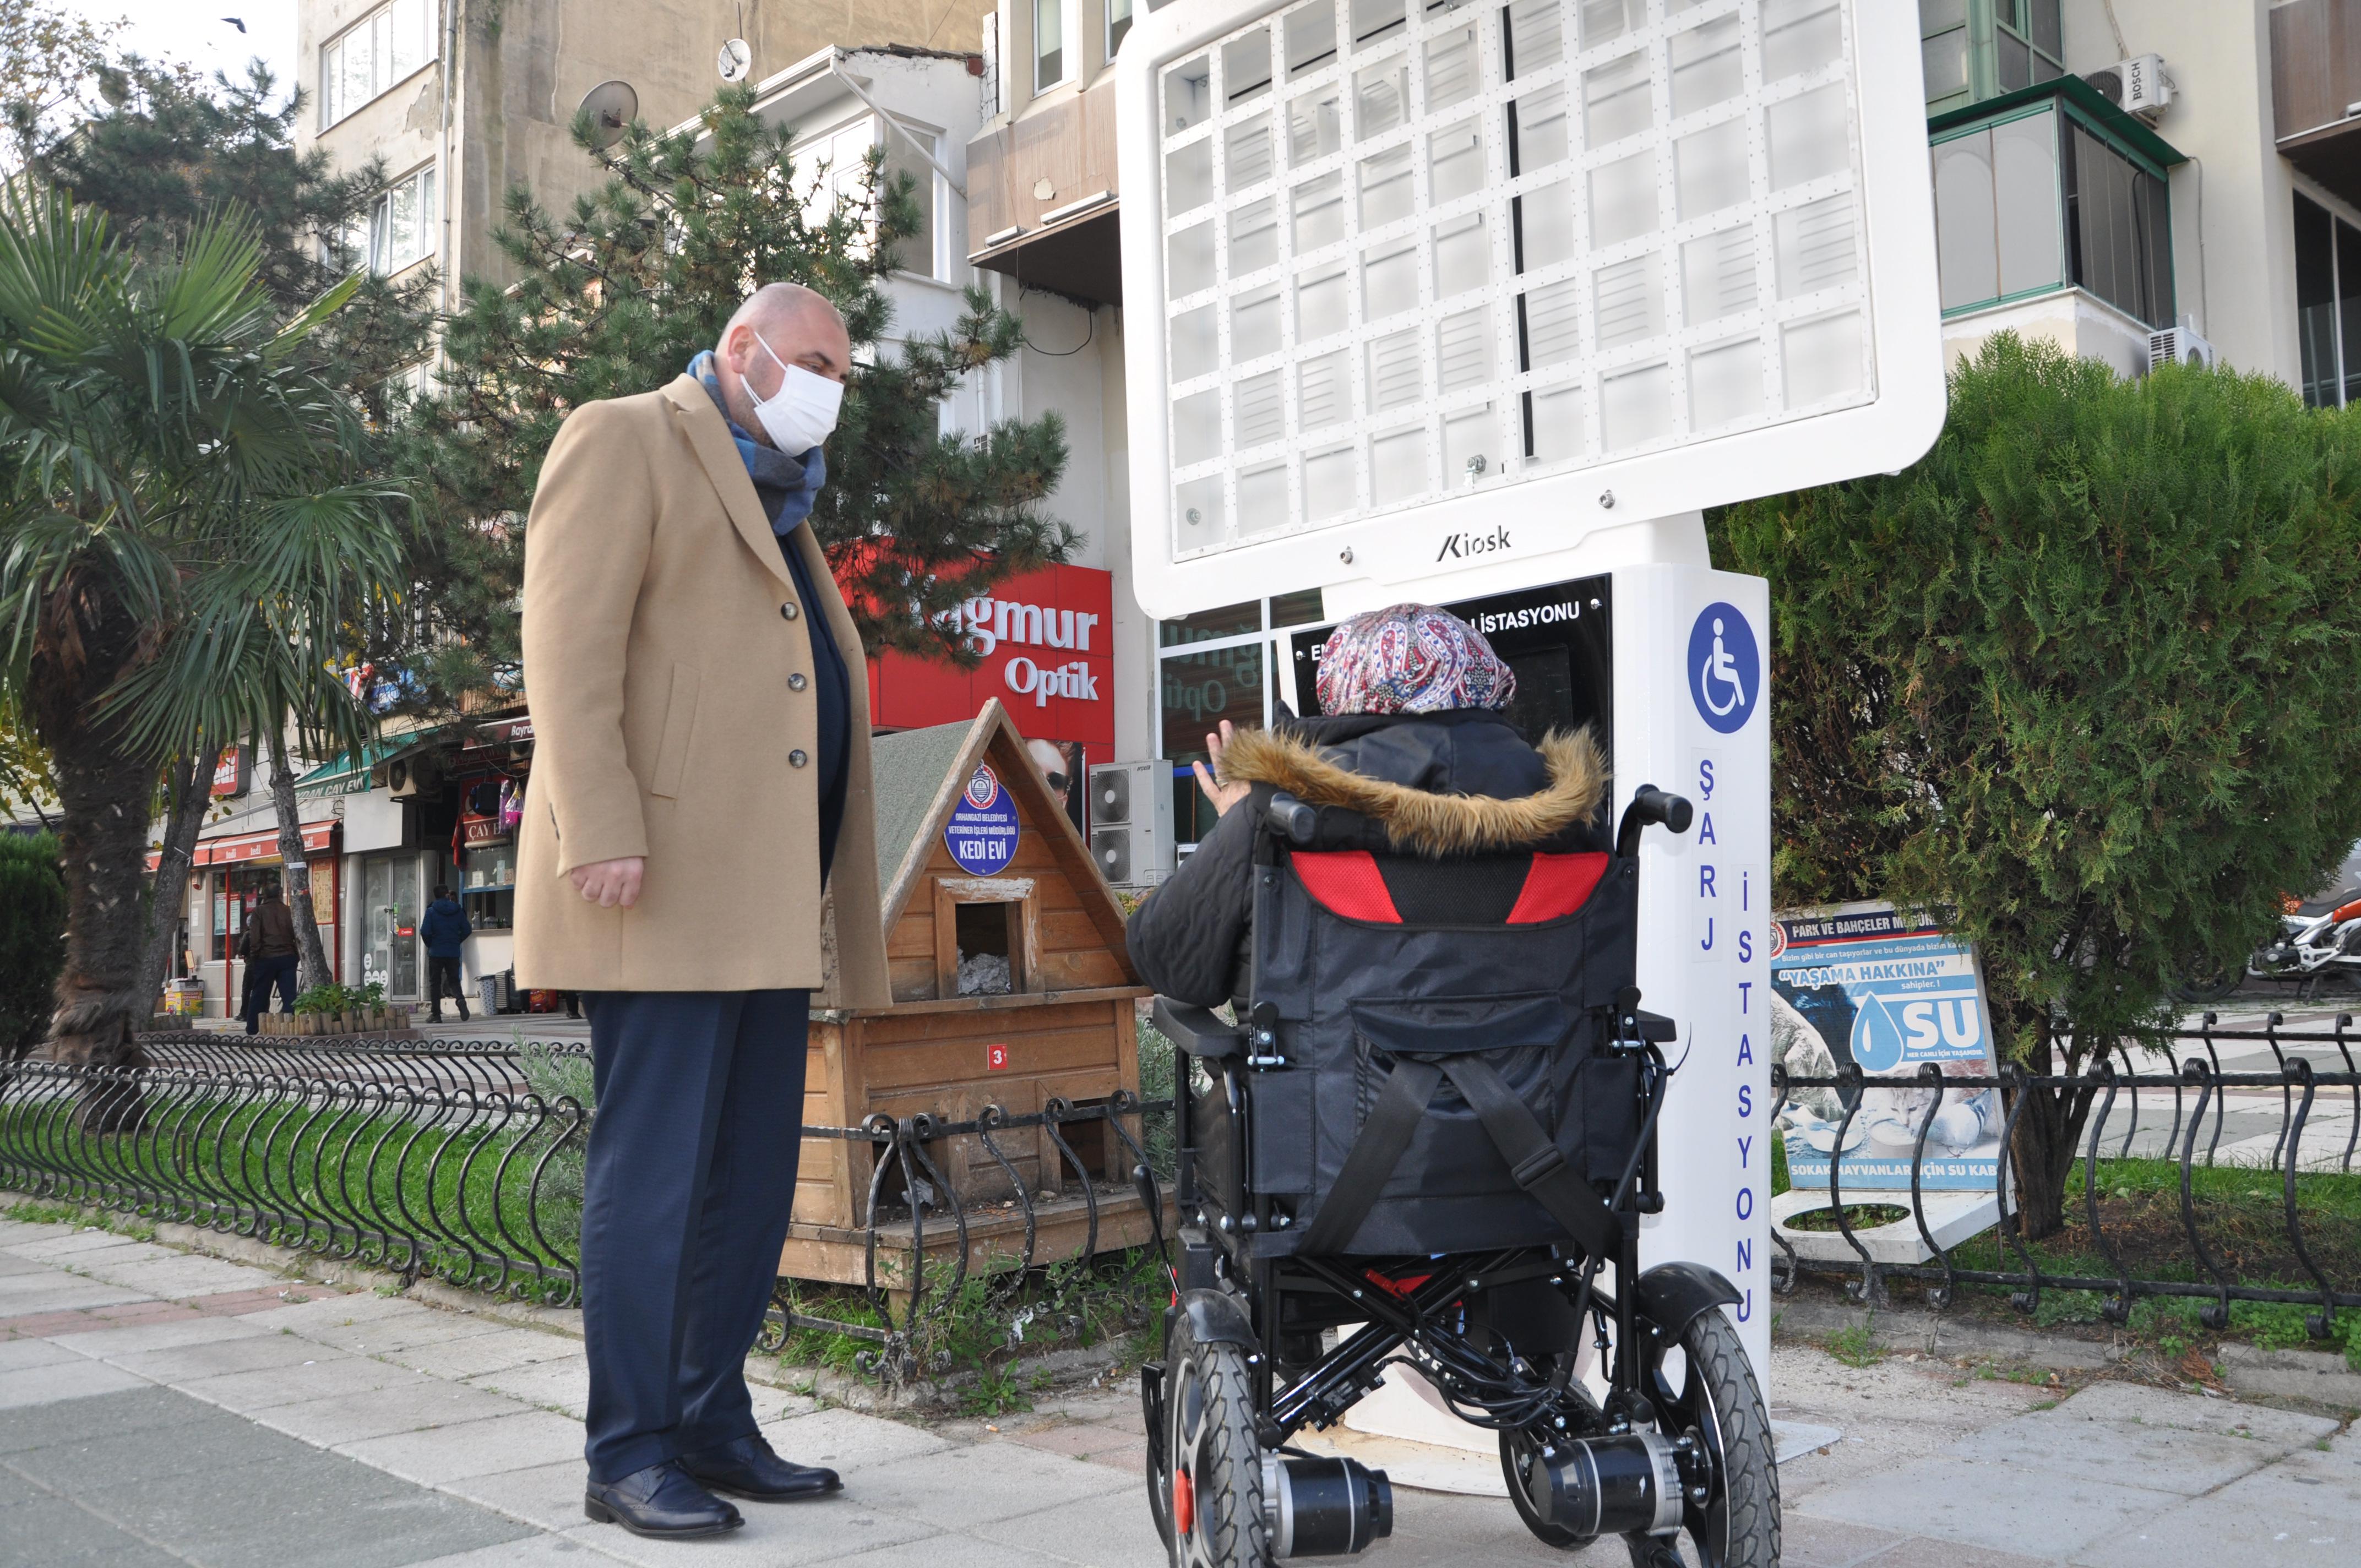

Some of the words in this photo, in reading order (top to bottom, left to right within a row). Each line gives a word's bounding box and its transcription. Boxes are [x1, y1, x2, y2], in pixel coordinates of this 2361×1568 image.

[2131, 62, 2141, 101] BOSCH
[1436, 525, 1511, 562] Kiosk
[1480, 601, 1580, 634] İSTASYONU
[1004, 657, 1099, 707] Optik
[511, 725, 535, 738] Bayra
[214, 756, 235, 785] edi
[955, 812, 982, 821] ORHANGAZİ
[982, 813, 1008, 822] BELEDİYESİ
[469, 823, 491, 841] ÇAY
[959, 837, 986, 859] KEDİ
[988, 838, 1007, 859] EVİ
[1699, 759, 1716, 951] ŞARJ
[1792, 924, 1820, 938] PARK
[1821, 922, 1835, 935] VE
[1836, 916, 1890, 934] BAHÇELER
[1801, 954, 1814, 962] gibi
[1840, 948, 1873, 959] taşıyorlar
[1895, 944, 1925, 956] dünyada
[1927, 942, 1946, 950] bizim
[1901, 979, 1935, 990] sahipler.
[1902, 999, 1980, 1049] SU
[993, 1050, 1003, 1064] 3
[1737, 872, 1753, 1322] İSTASYONU
[1791, 1165, 1831, 1175] SOKAK
[1948, 1165, 1966, 1176] SU
[1969, 1165, 1998, 1176] KAB
